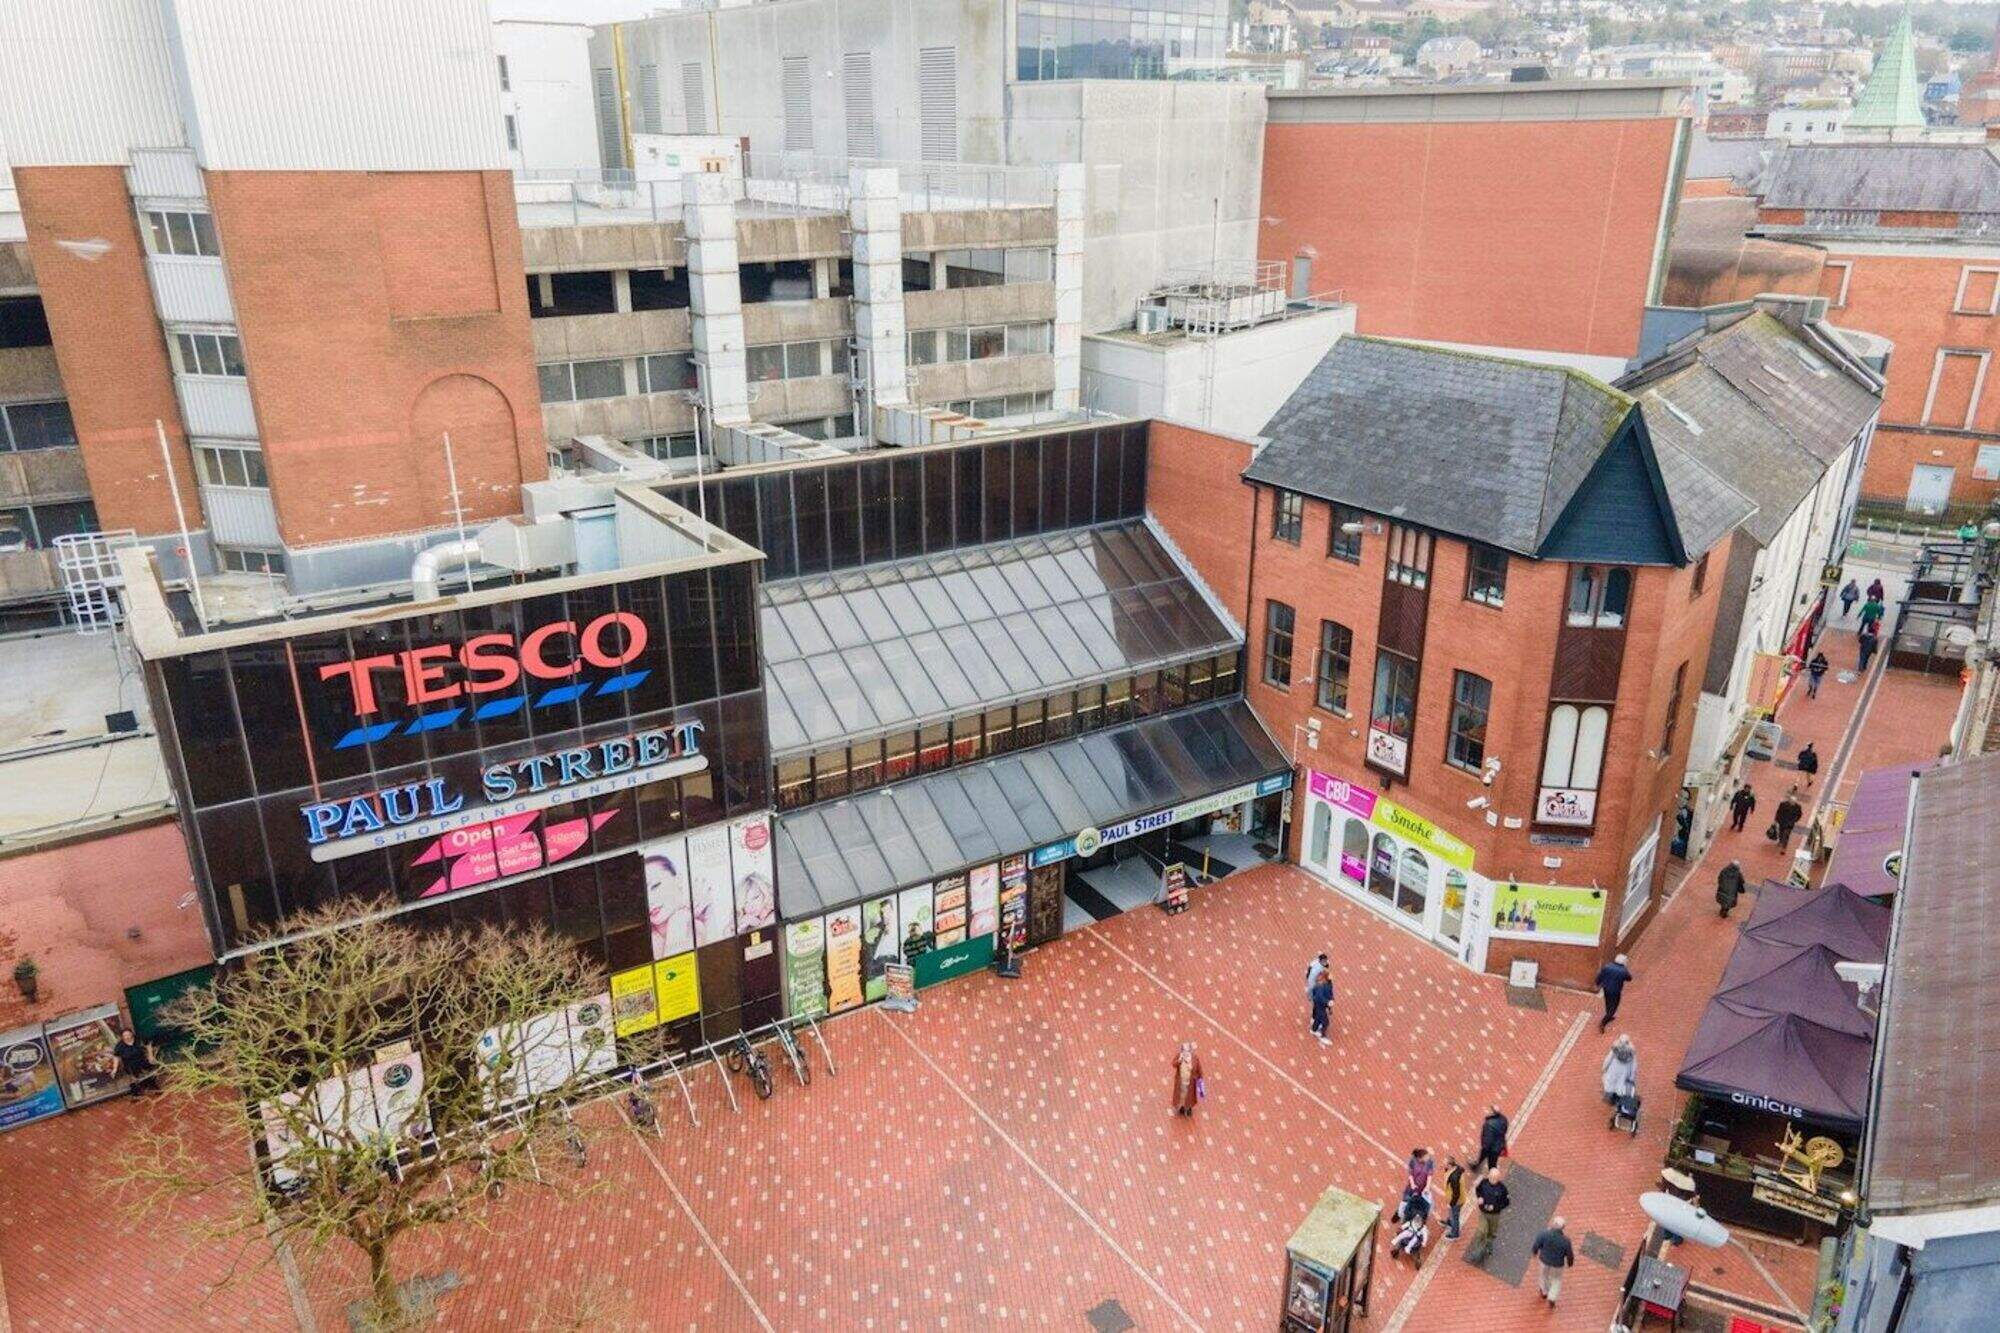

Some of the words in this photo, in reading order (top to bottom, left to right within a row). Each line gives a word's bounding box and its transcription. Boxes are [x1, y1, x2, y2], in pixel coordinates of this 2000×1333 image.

[320, 612, 648, 715] TESCO
[302, 777, 462, 843] PAUL
[483, 721, 705, 802] STREET
[1326, 779, 1351, 801] CBD
[374, 803, 528, 847] SHOPPING
[551, 772, 656, 804] CENTRE
[1390, 809, 1433, 840] Smoke
[452, 825, 505, 847] Open
[1101, 826, 1130, 843] PAUL
[1135, 810, 1174, 832] STREET
[1534, 900, 1572, 912] Smoke
[1731, 1091, 1803, 1118] amicus
